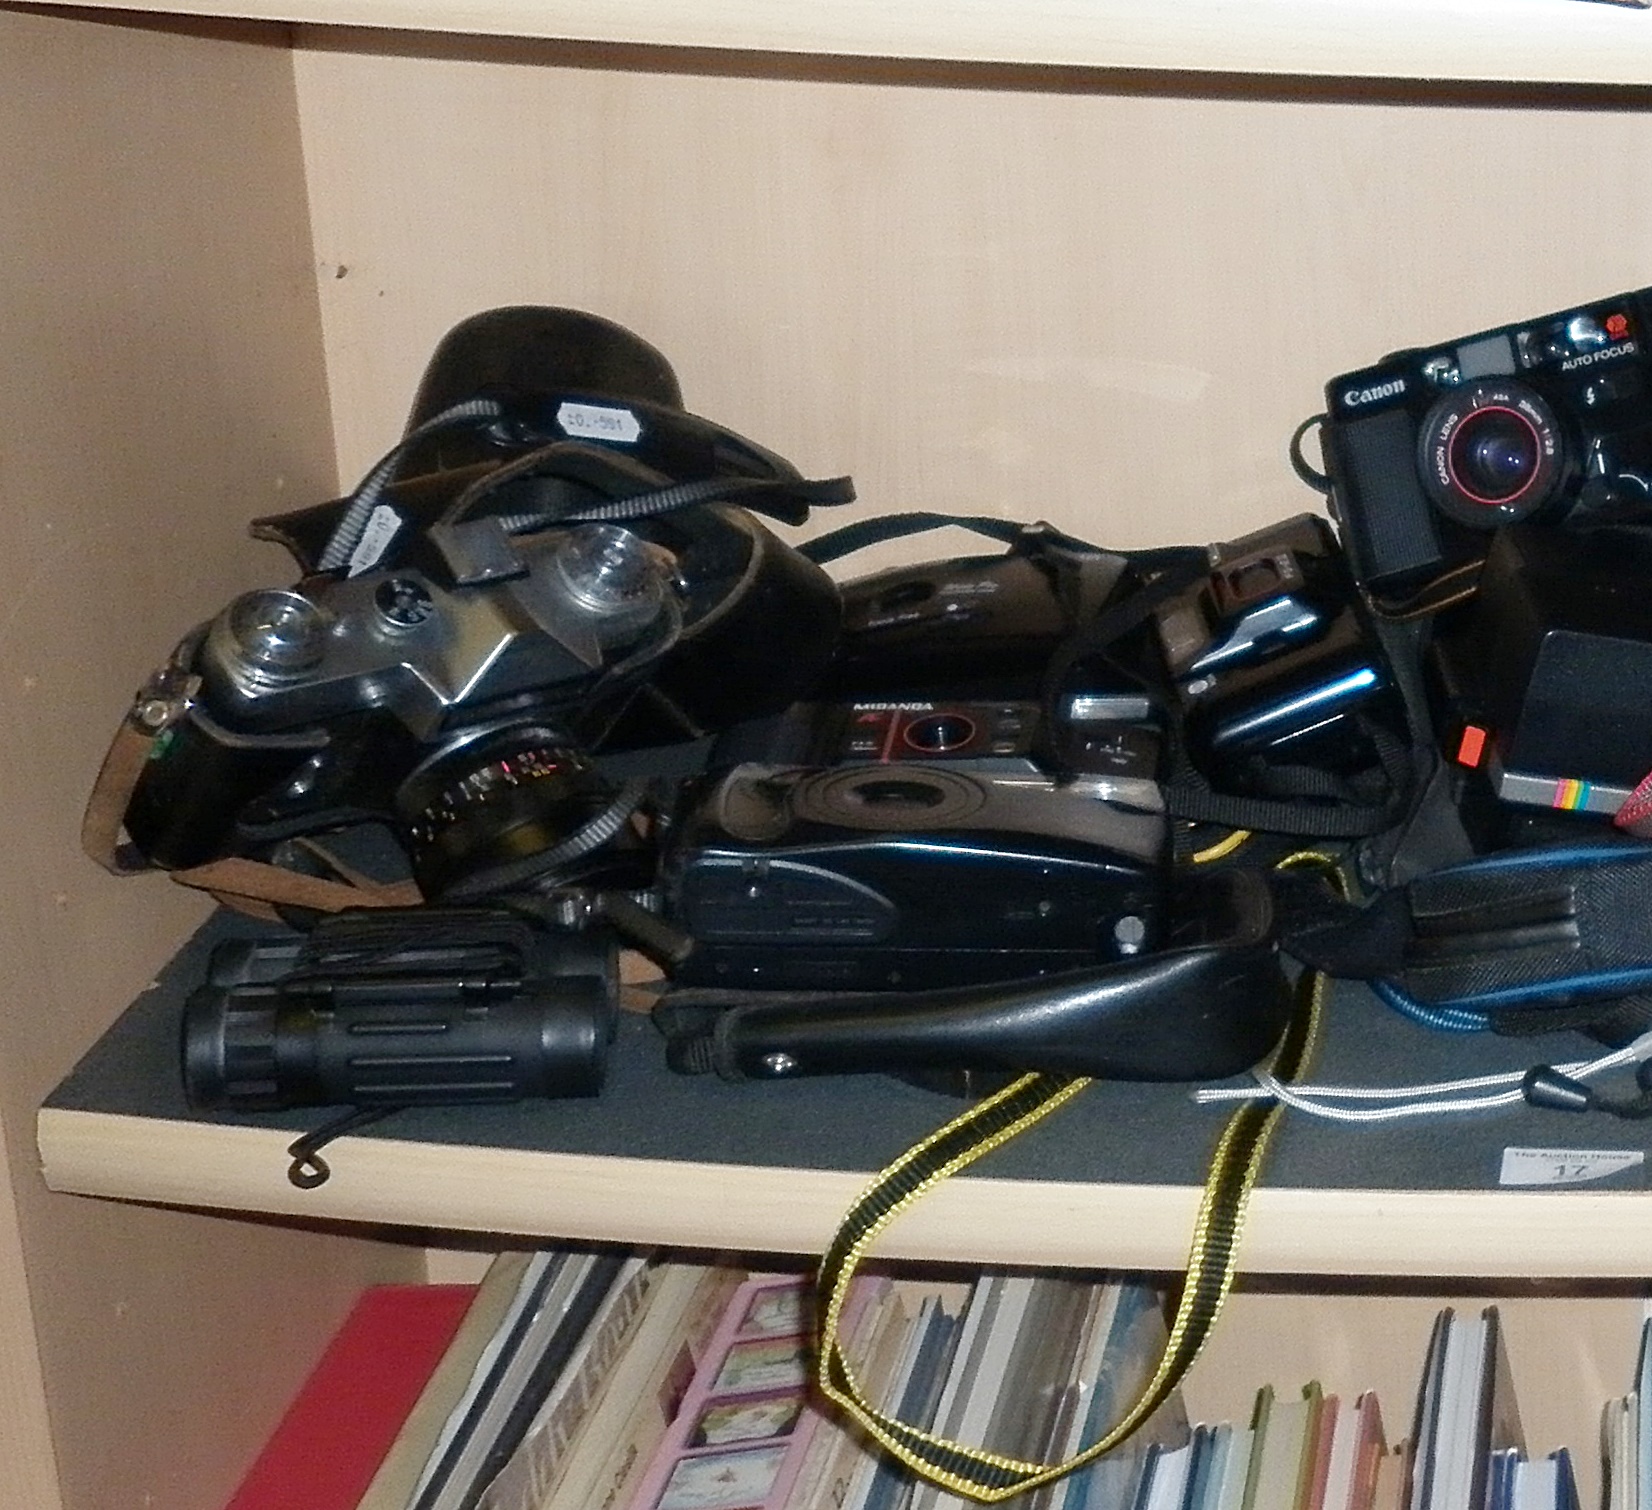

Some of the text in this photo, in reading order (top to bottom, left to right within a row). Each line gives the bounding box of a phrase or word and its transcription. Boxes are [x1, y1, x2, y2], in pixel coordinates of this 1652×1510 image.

[1562, 341, 1635, 371] AUTO FOCUS
[1344, 378, 1406, 406] Canon
[1435, 412, 1459, 487] CANON LENS
[853, 702, 934, 711] MIRANDA
[1540, 1151, 1588, 1159] Auction
[1554, 1164, 1588, 1177] 17
